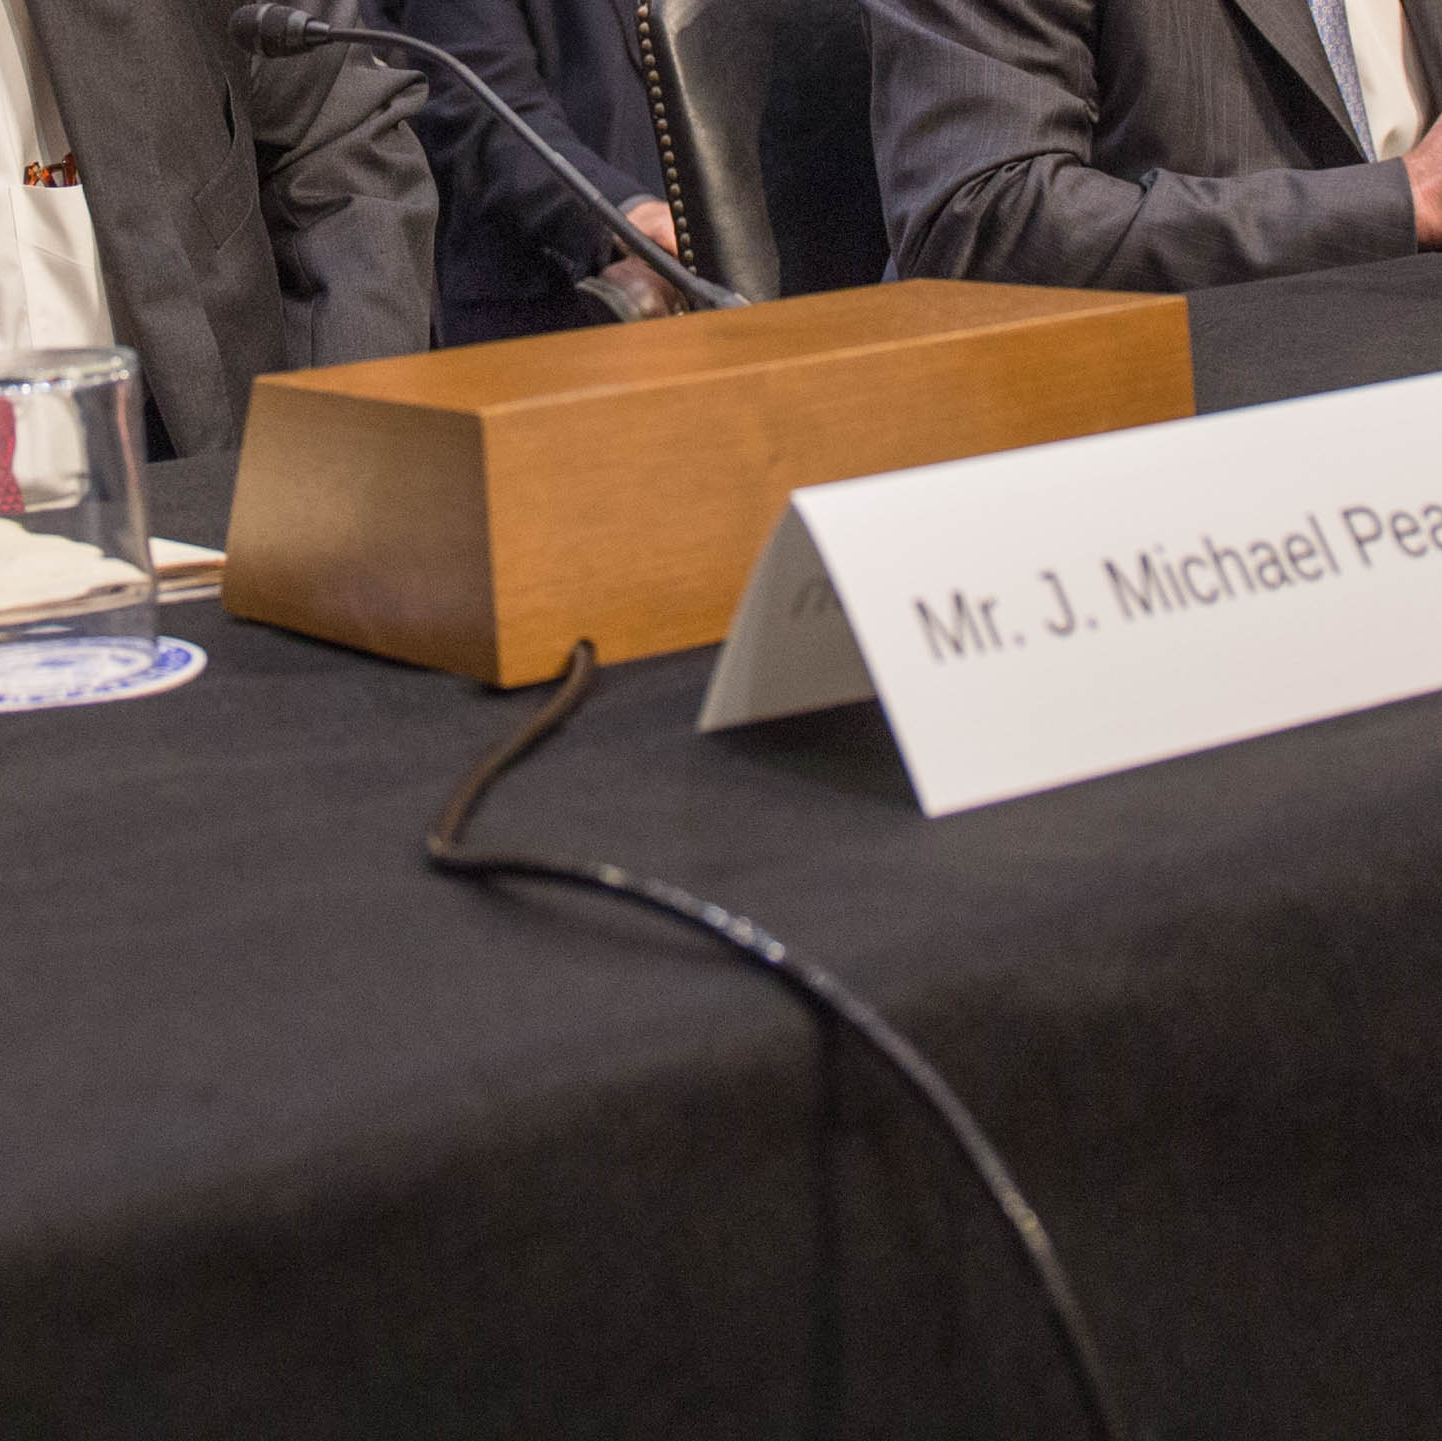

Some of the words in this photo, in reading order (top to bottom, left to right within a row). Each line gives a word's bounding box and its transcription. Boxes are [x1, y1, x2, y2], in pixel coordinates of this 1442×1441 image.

[911, 587, 1026, 661] Mr.
[1040, 570, 1099, 638] J.
[1100, 513, 1341, 622] Michael
